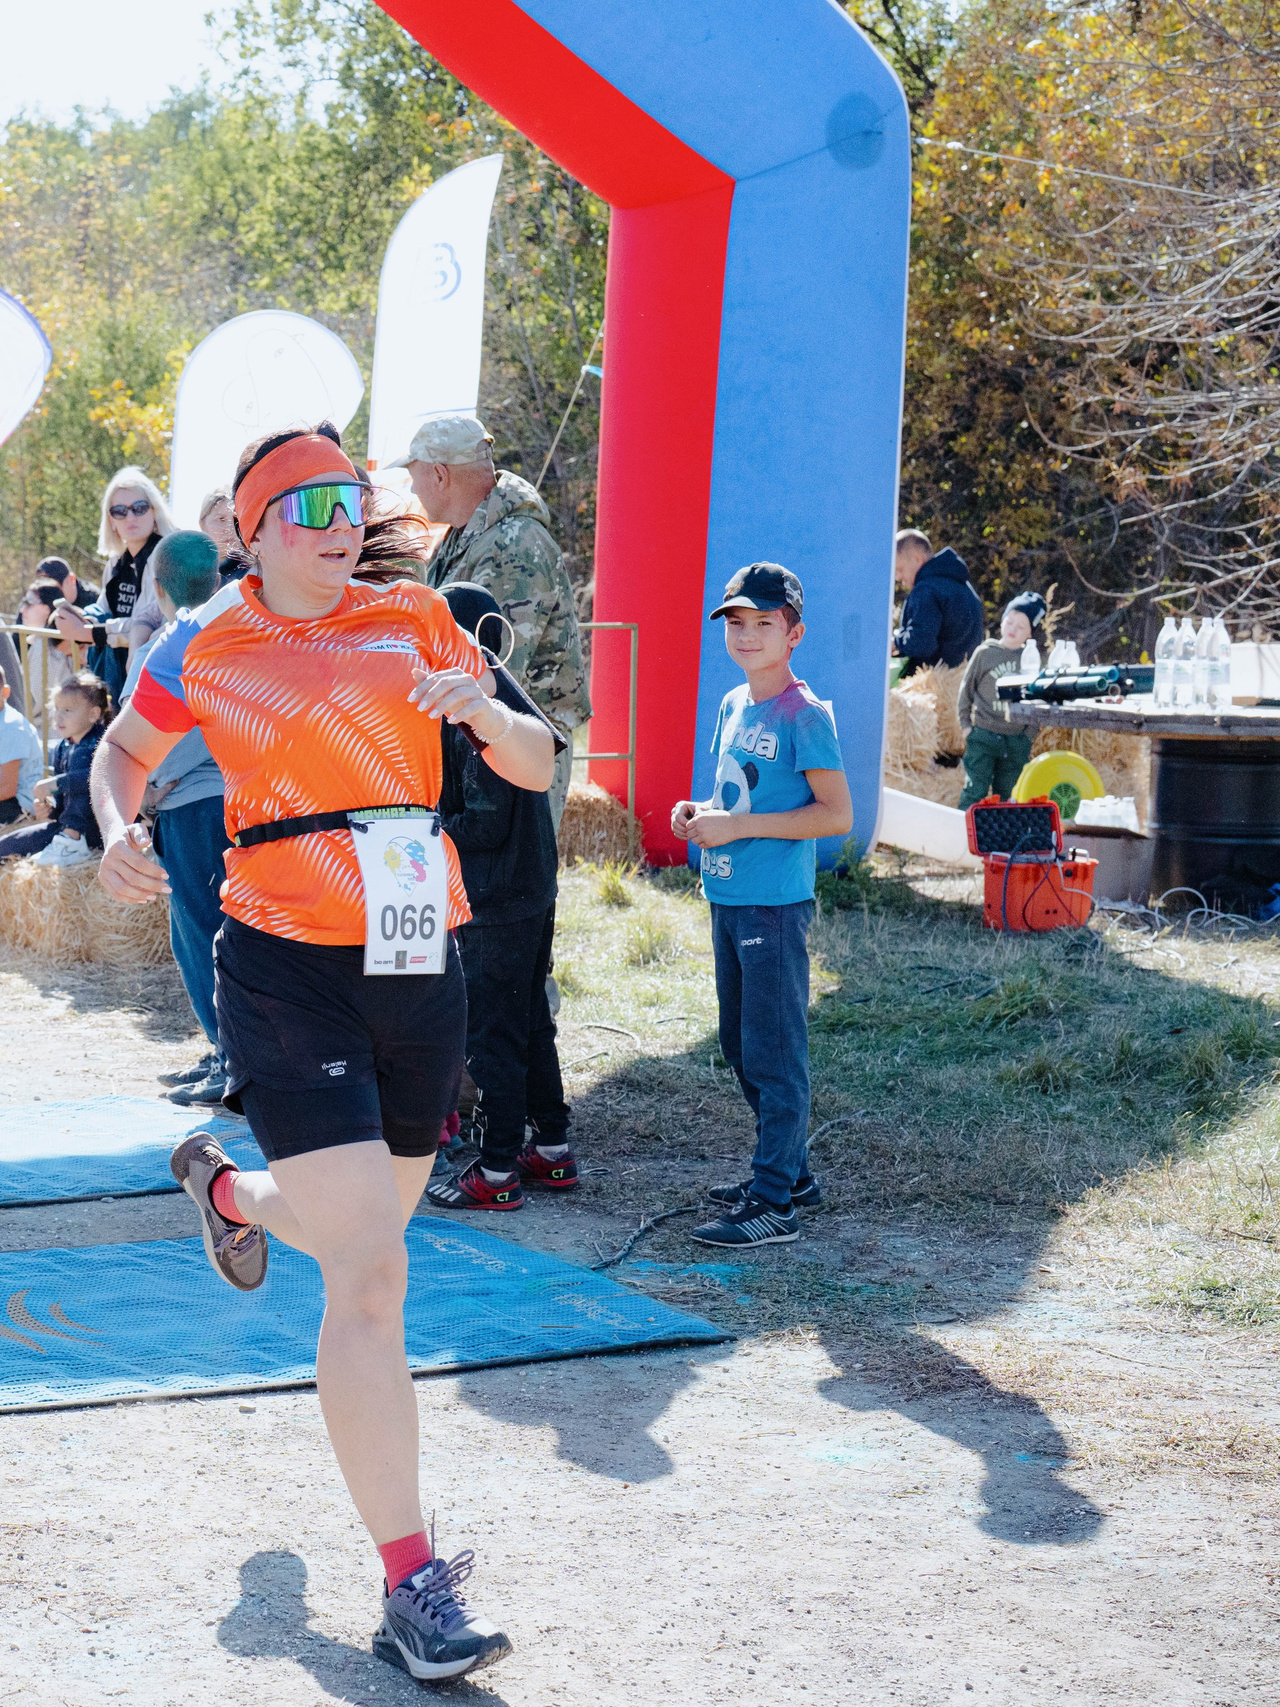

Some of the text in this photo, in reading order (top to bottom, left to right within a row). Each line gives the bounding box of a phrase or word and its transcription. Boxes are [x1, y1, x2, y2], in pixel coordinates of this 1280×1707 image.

[727, 722, 778, 760] nda
[380, 904, 436, 942] 066
[551, 1168, 565, 1179] C7
[496, 1191, 510, 1202] C7
